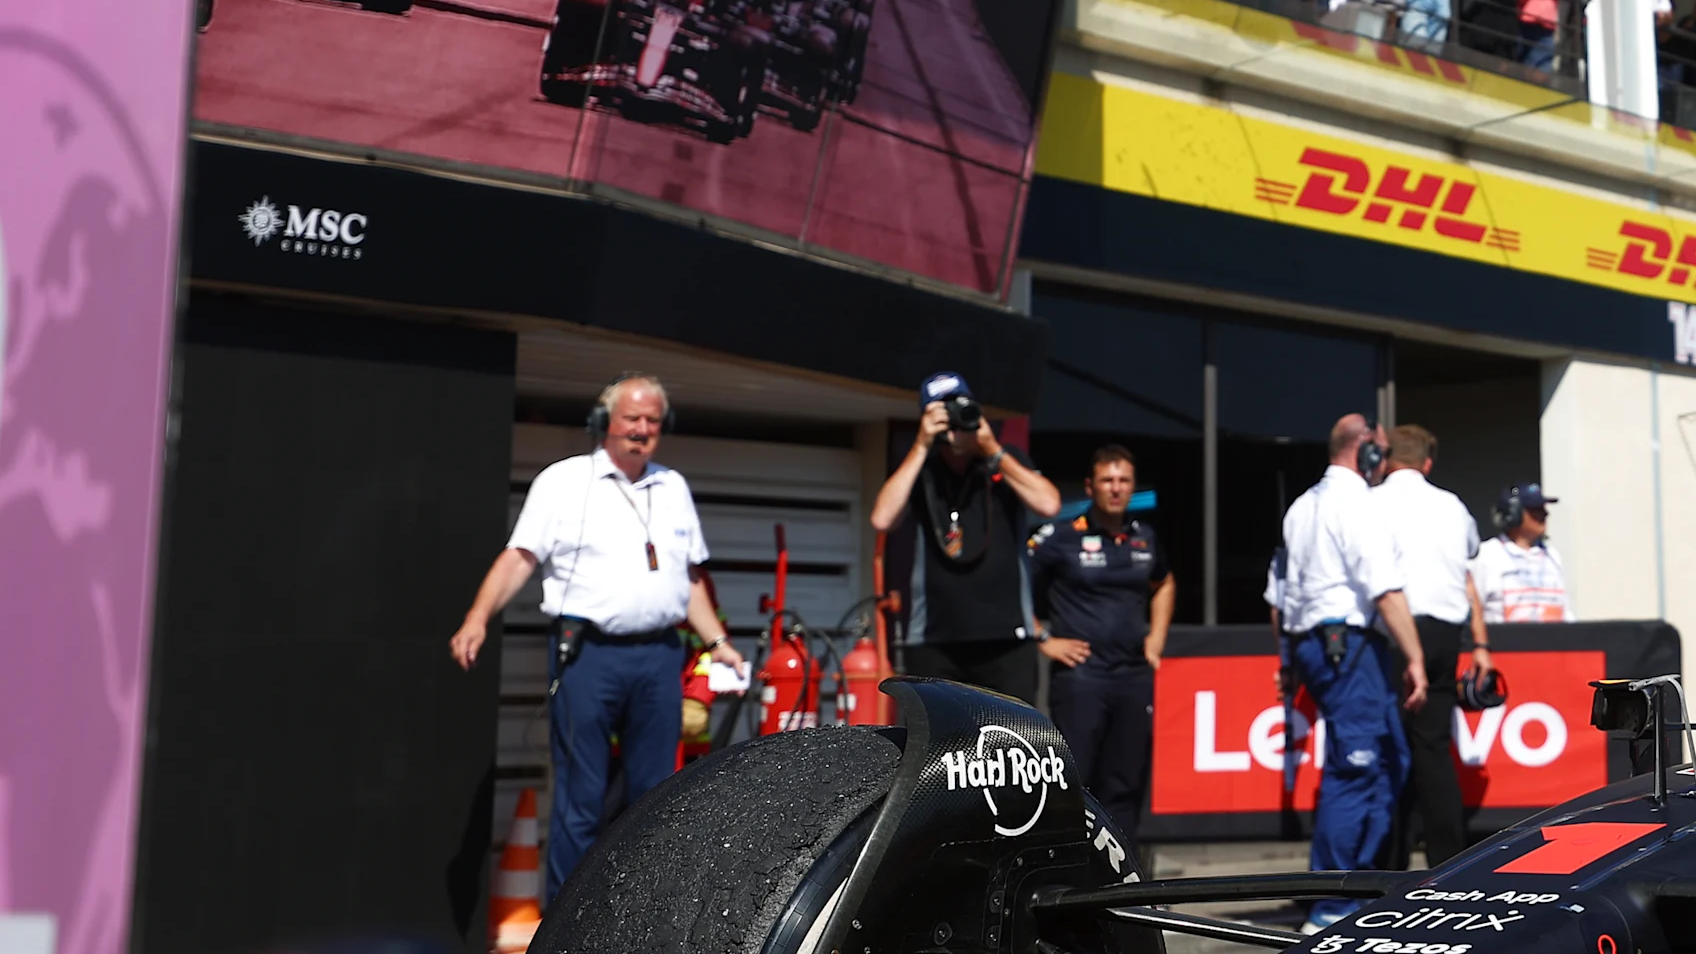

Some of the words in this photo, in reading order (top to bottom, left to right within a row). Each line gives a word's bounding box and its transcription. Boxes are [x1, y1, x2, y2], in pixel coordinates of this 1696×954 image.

[1296, 147, 1488, 244] DHL
[283, 204, 368, 245] MSC
[280, 239, 363, 261] CRUISES
[1007, 745, 1068, 794] Rock
[1404, 889, 1486, 902] Cash
[1486, 890, 1560, 904] App
[1355, 907, 1525, 932] citrix
[1355, 937, 1473, 954] Tezos
